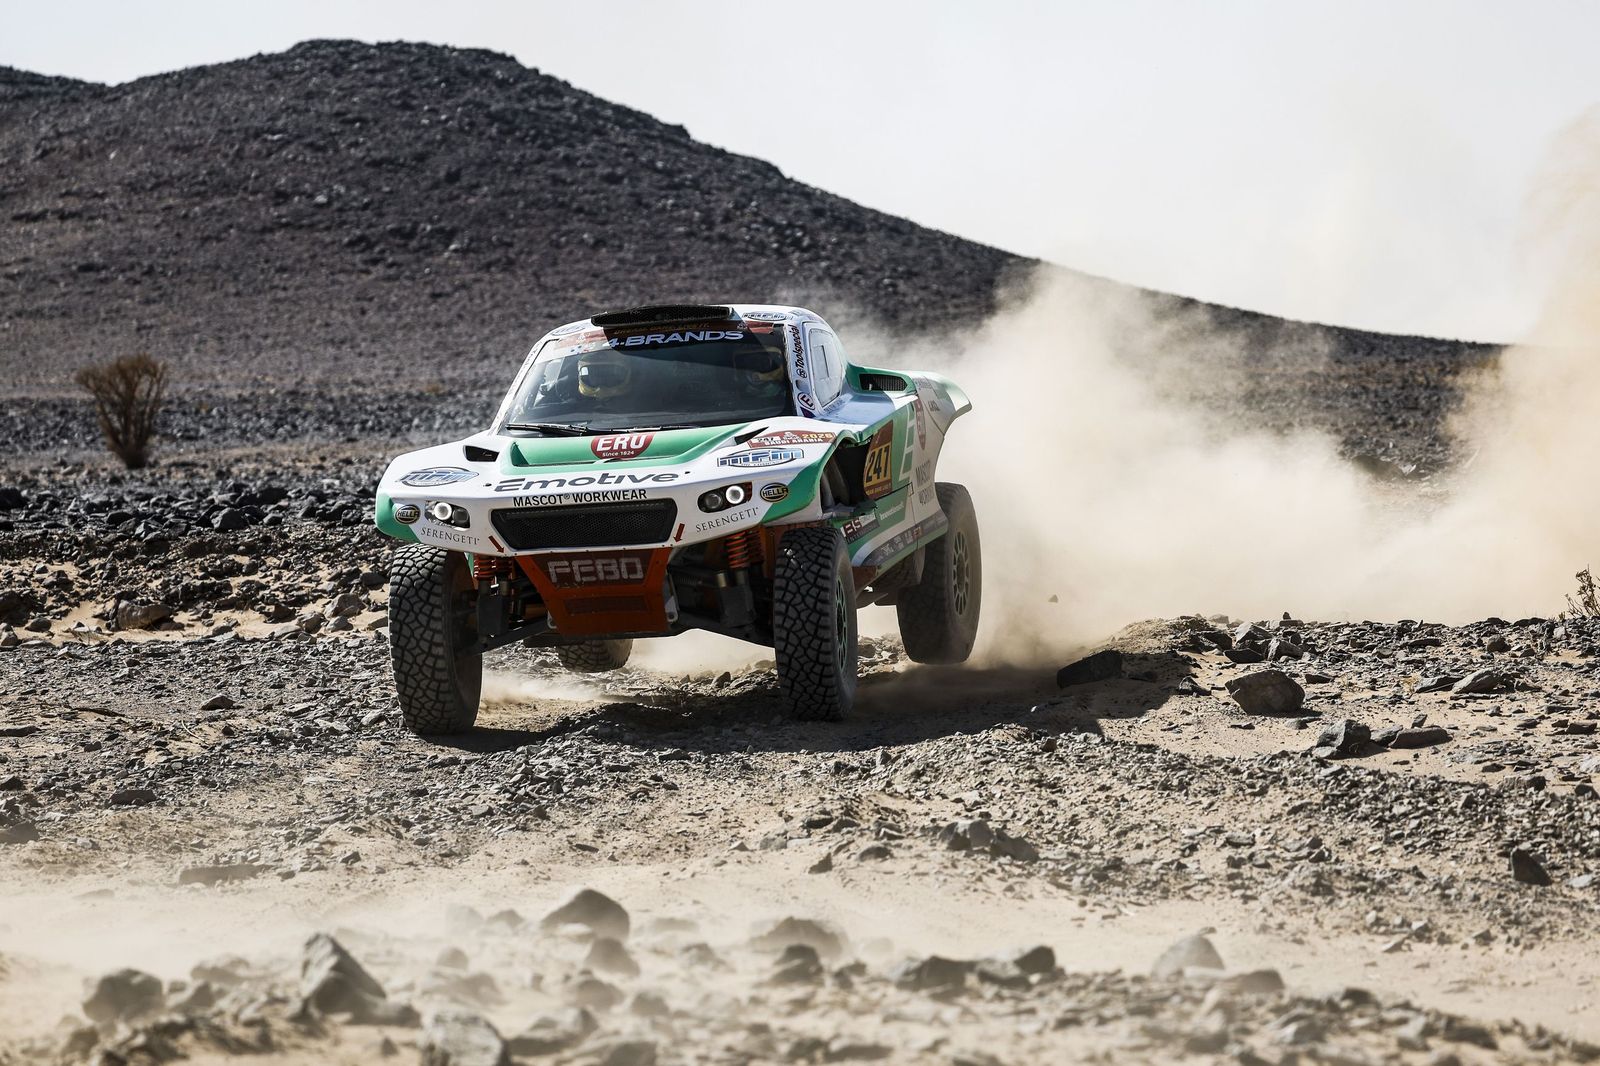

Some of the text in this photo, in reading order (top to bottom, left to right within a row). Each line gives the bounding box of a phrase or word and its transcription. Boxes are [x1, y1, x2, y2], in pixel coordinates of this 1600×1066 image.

[596, 434, 647, 451] ERU
[494, 472, 679, 493] Emotive
[572, 489, 647, 504] WORKWEAR
[762, 487, 788, 496] HELLA
[397, 509, 420, 518] HELLA
[547, 558, 643, 582] FEBO
